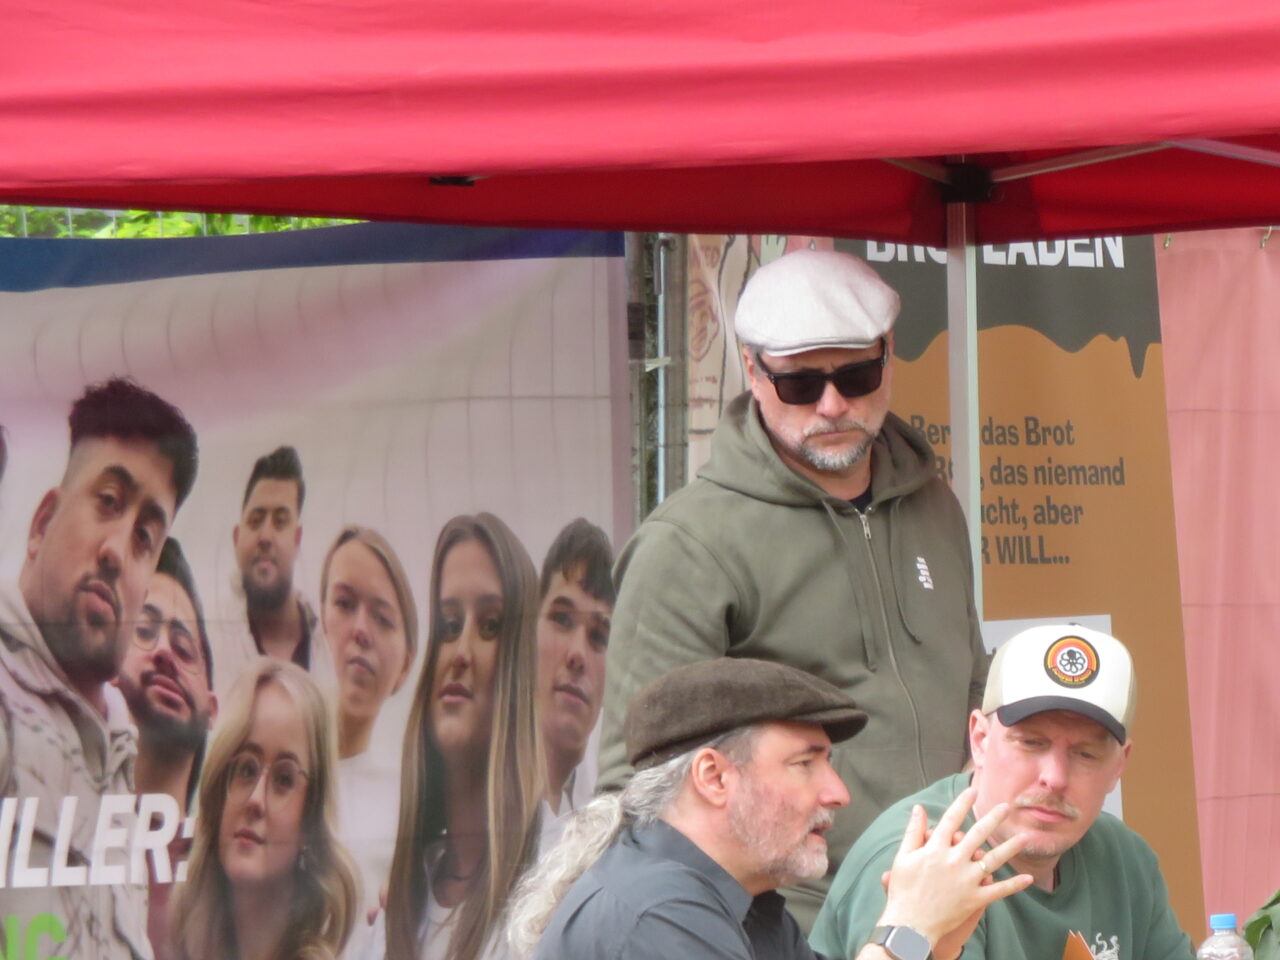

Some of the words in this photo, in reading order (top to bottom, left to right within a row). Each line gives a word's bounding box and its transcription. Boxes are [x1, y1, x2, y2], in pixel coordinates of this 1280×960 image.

[981, 417, 1020, 446] das
[1024, 416, 1075, 446] Brot
[990, 456, 1028, 485] das
[1034, 457, 1125, 486] niemand
[1033, 496, 1084, 525] aber
[995, 536, 1071, 564] WILL...
